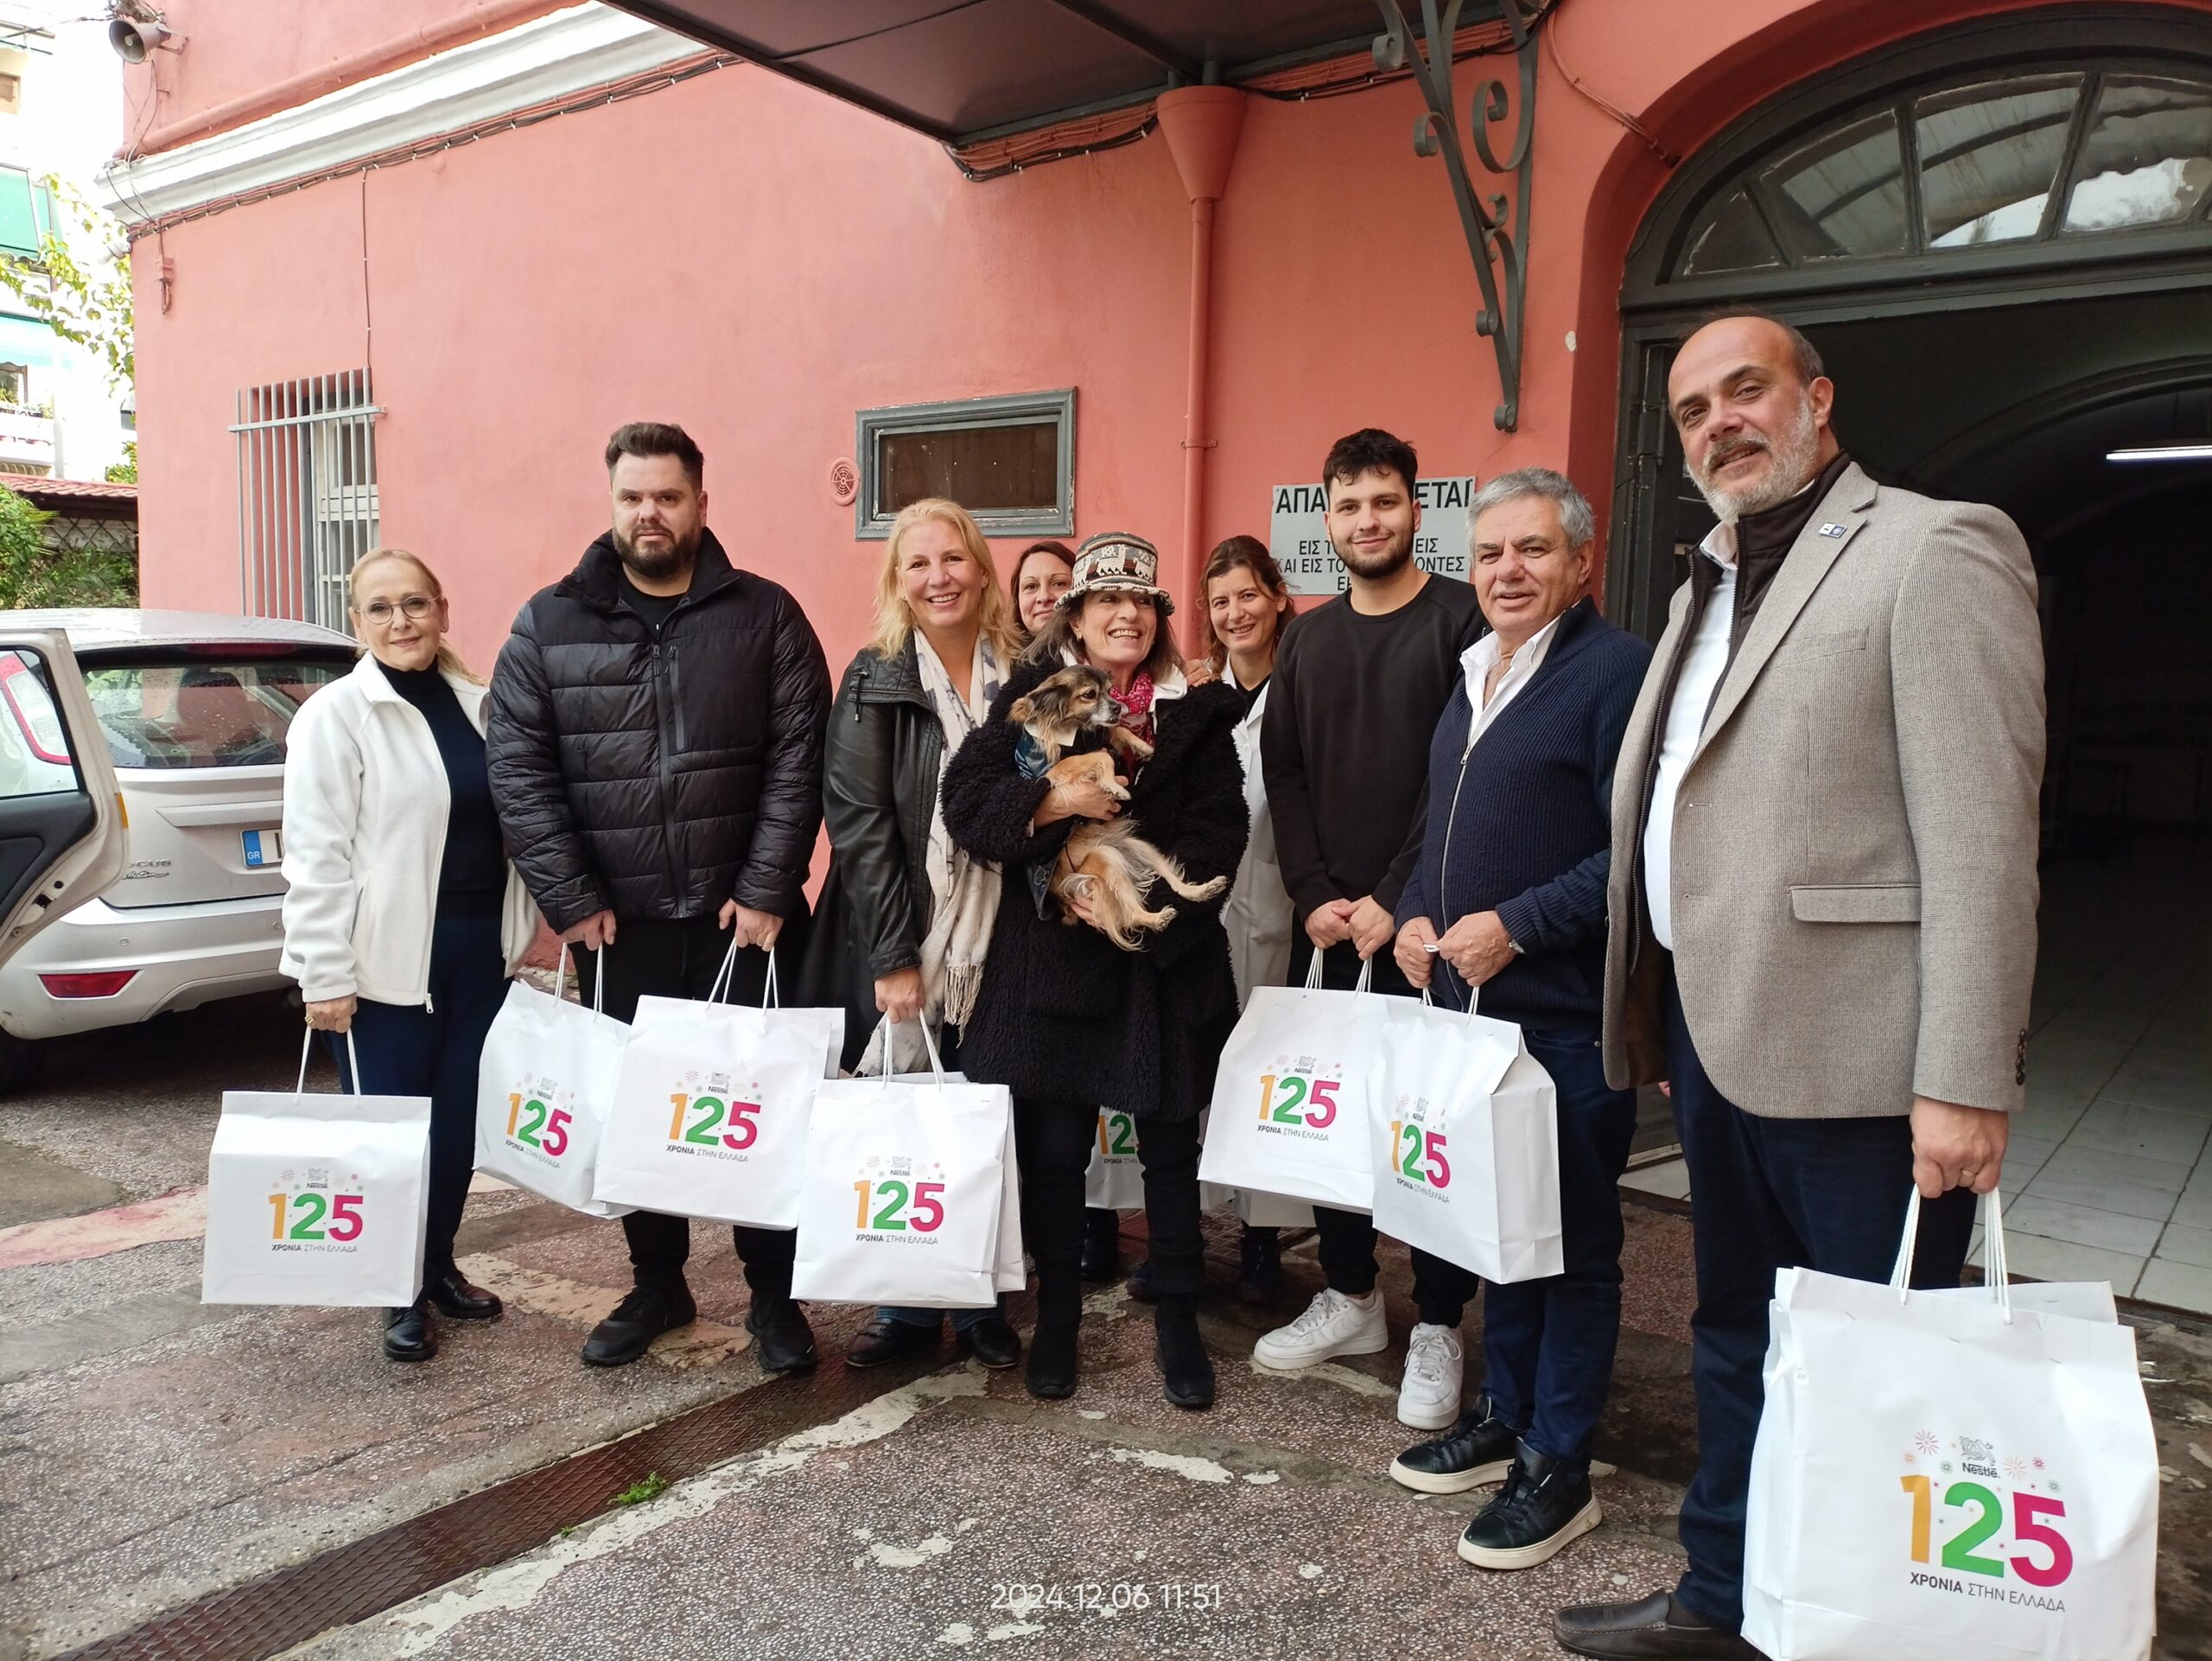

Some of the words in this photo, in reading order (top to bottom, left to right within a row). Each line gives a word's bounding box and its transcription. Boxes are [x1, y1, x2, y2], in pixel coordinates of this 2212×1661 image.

[1276, 479, 1471, 513] ΑΠΑΕΤΑΙ
[1275, 557, 1297, 573] ΚΑΙ
[1301, 557, 1323, 573] ΕΙΣ
[1327, 557, 1346, 573] ΤΟ
[1299, 540, 1320, 555] ΕΙΣ
[129, 859, 172, 869] CUS
[247, 851, 262, 860] GR
[669, 1093, 761, 1149] 125
[1259, 1075, 1340, 1129] 125
[506, 1092, 572, 1156] 125
[1098, 1114, 1140, 1155] 12
[666, 1144, 695, 1155] ΧΡΟΝΙΑ
[1391, 1120, 1451, 1188] 125
[268, 1193, 364, 1242] 125
[854, 1180, 944, 1231] 125
[1900, 1473, 2074, 1588] 125
[1910, 1572, 1963, 1594] ΧΡΟΝΙΑ
[1967, 1583, 2005, 1601] ΣΤΗΝ
[2009, 1591, 2066, 1613] ΕΛΛΑΔΑ
